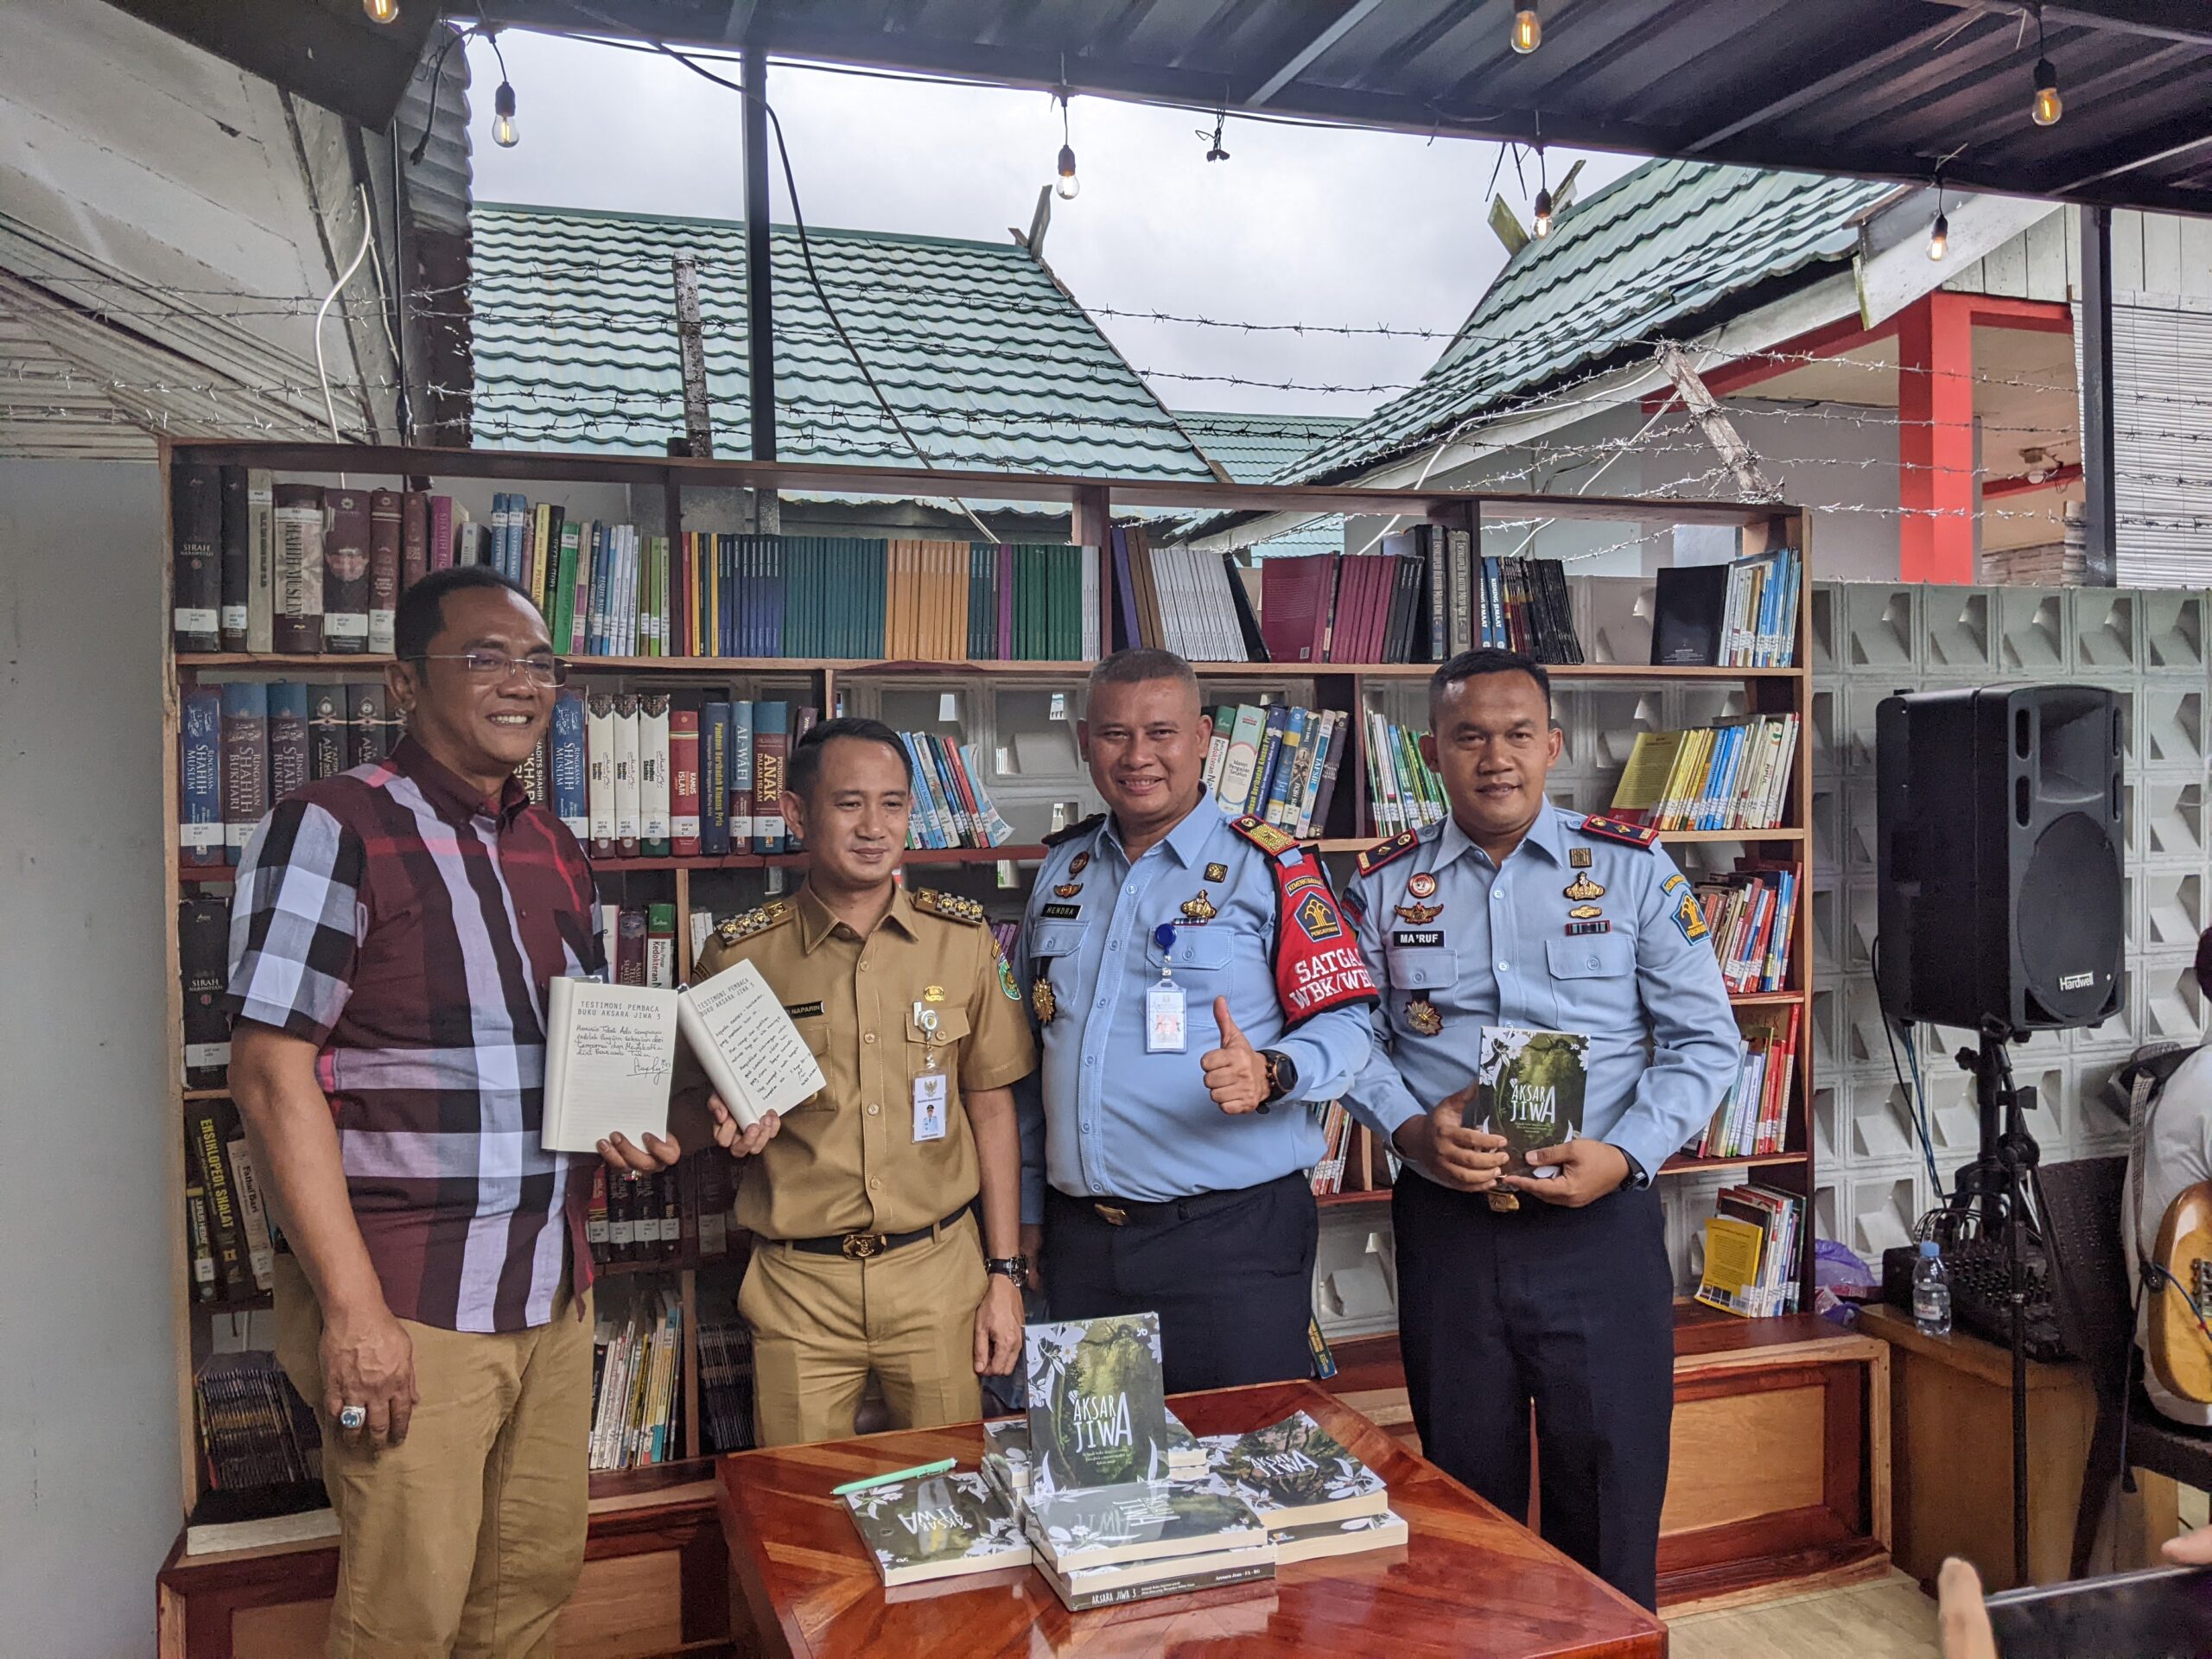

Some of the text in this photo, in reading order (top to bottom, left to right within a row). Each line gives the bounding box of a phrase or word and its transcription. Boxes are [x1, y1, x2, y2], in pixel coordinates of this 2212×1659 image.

[285, 569, 302, 619] MUSLIM
[1492, 604, 1501, 628] JEMAAT
[196, 745, 207, 795] SHAHIH
[564, 742, 575, 790] SHAHIH
[715, 752, 723, 785] Beribadah
[1208, 739, 1220, 774] Kedokteran
[1230, 764, 1249, 773] Pengajian
[1251, 766, 1263, 795] Beribadah
[1258, 744, 1268, 765] Khusus
[1311, 757, 1323, 785] TAFSIR
[229, 754, 239, 810] BUKHARI
[239, 747, 253, 812] SHAHIH
[764, 753, 776, 802] ANAK
[1047, 907, 1074, 916] HENDRA
[1400, 933, 1439, 944] MA'RUF
[652, 942, 660, 982] Kedokteran
[696, 976, 749, 1010] TESTIMONI PEMBACA
[2059, 971, 2094, 991] Hardwell
[581, 1001, 622, 1010] TESTIMONI
[699, 1004, 715, 1017] BUKU
[714, 993, 734, 1008] AKSARA
[735, 985, 749, 996] JIWA
[791, 1005, 820, 1014] NAPARIN
[200, 1119, 233, 1228] ENSIKLOPEDI SHALAT
[1091, 1589, 1136, 1605] AKSARA JIWA 3
